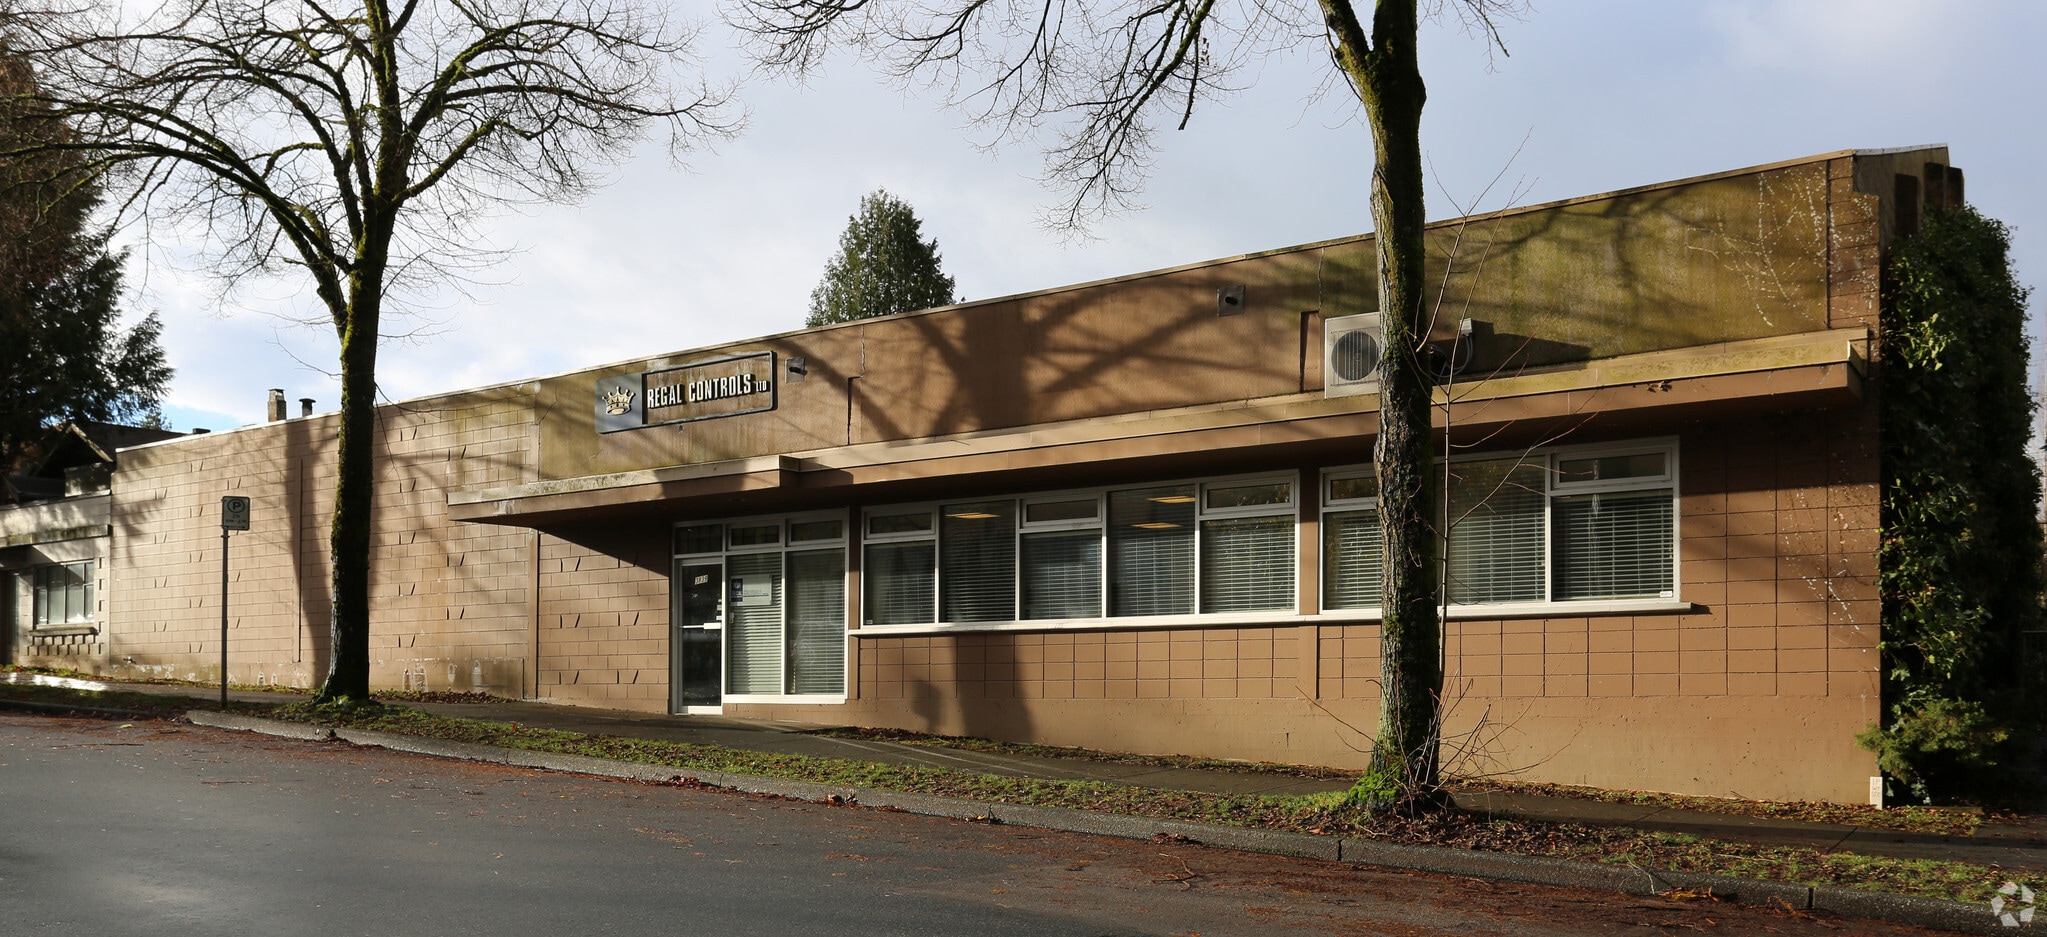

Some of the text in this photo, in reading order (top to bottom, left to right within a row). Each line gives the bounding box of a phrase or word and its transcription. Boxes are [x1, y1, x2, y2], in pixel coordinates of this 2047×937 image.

[647, 373, 767, 408] REGAL CONTROLS LTD
[232, 501, 241, 510] P
